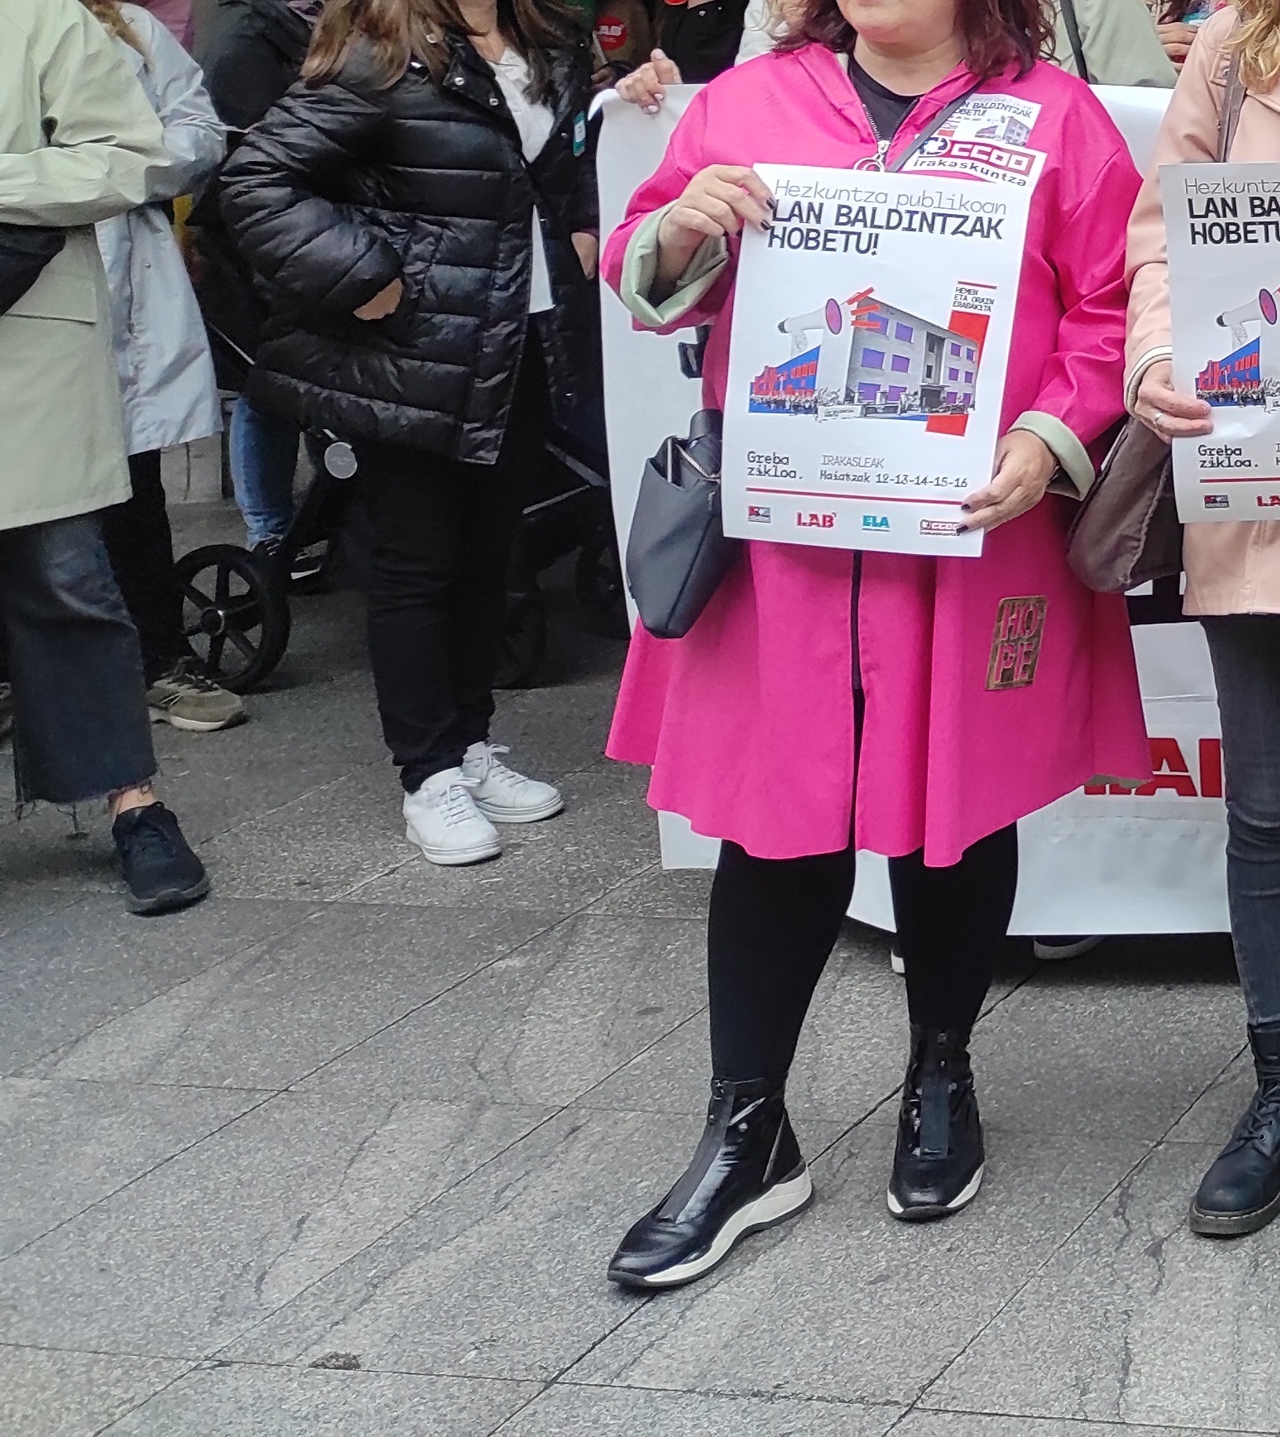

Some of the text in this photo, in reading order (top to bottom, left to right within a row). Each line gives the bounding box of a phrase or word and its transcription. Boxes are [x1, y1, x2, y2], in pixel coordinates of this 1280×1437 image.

[954, 109, 986, 117] OBETU!
[951, 143, 1030, 171] CCOO
[914, 159, 1026, 186] irakaskuntza
[775, 180, 1006, 215] Hezkuntza publikoan
[1187, 196, 1237, 219] LAN
[771, 199, 1004, 239] LAN BALDINTZAK
[767, 226, 879, 255] HOBETU!
[747, 451, 790, 466] Greba
[1198, 445, 1243, 458] Greba
[821, 454, 885, 469] IRAKASLEAK
[875, 472, 968, 488] 12-13-14-15-16
[797, 512, 836, 528] LAB
[862, 515, 890, 528] ELA
